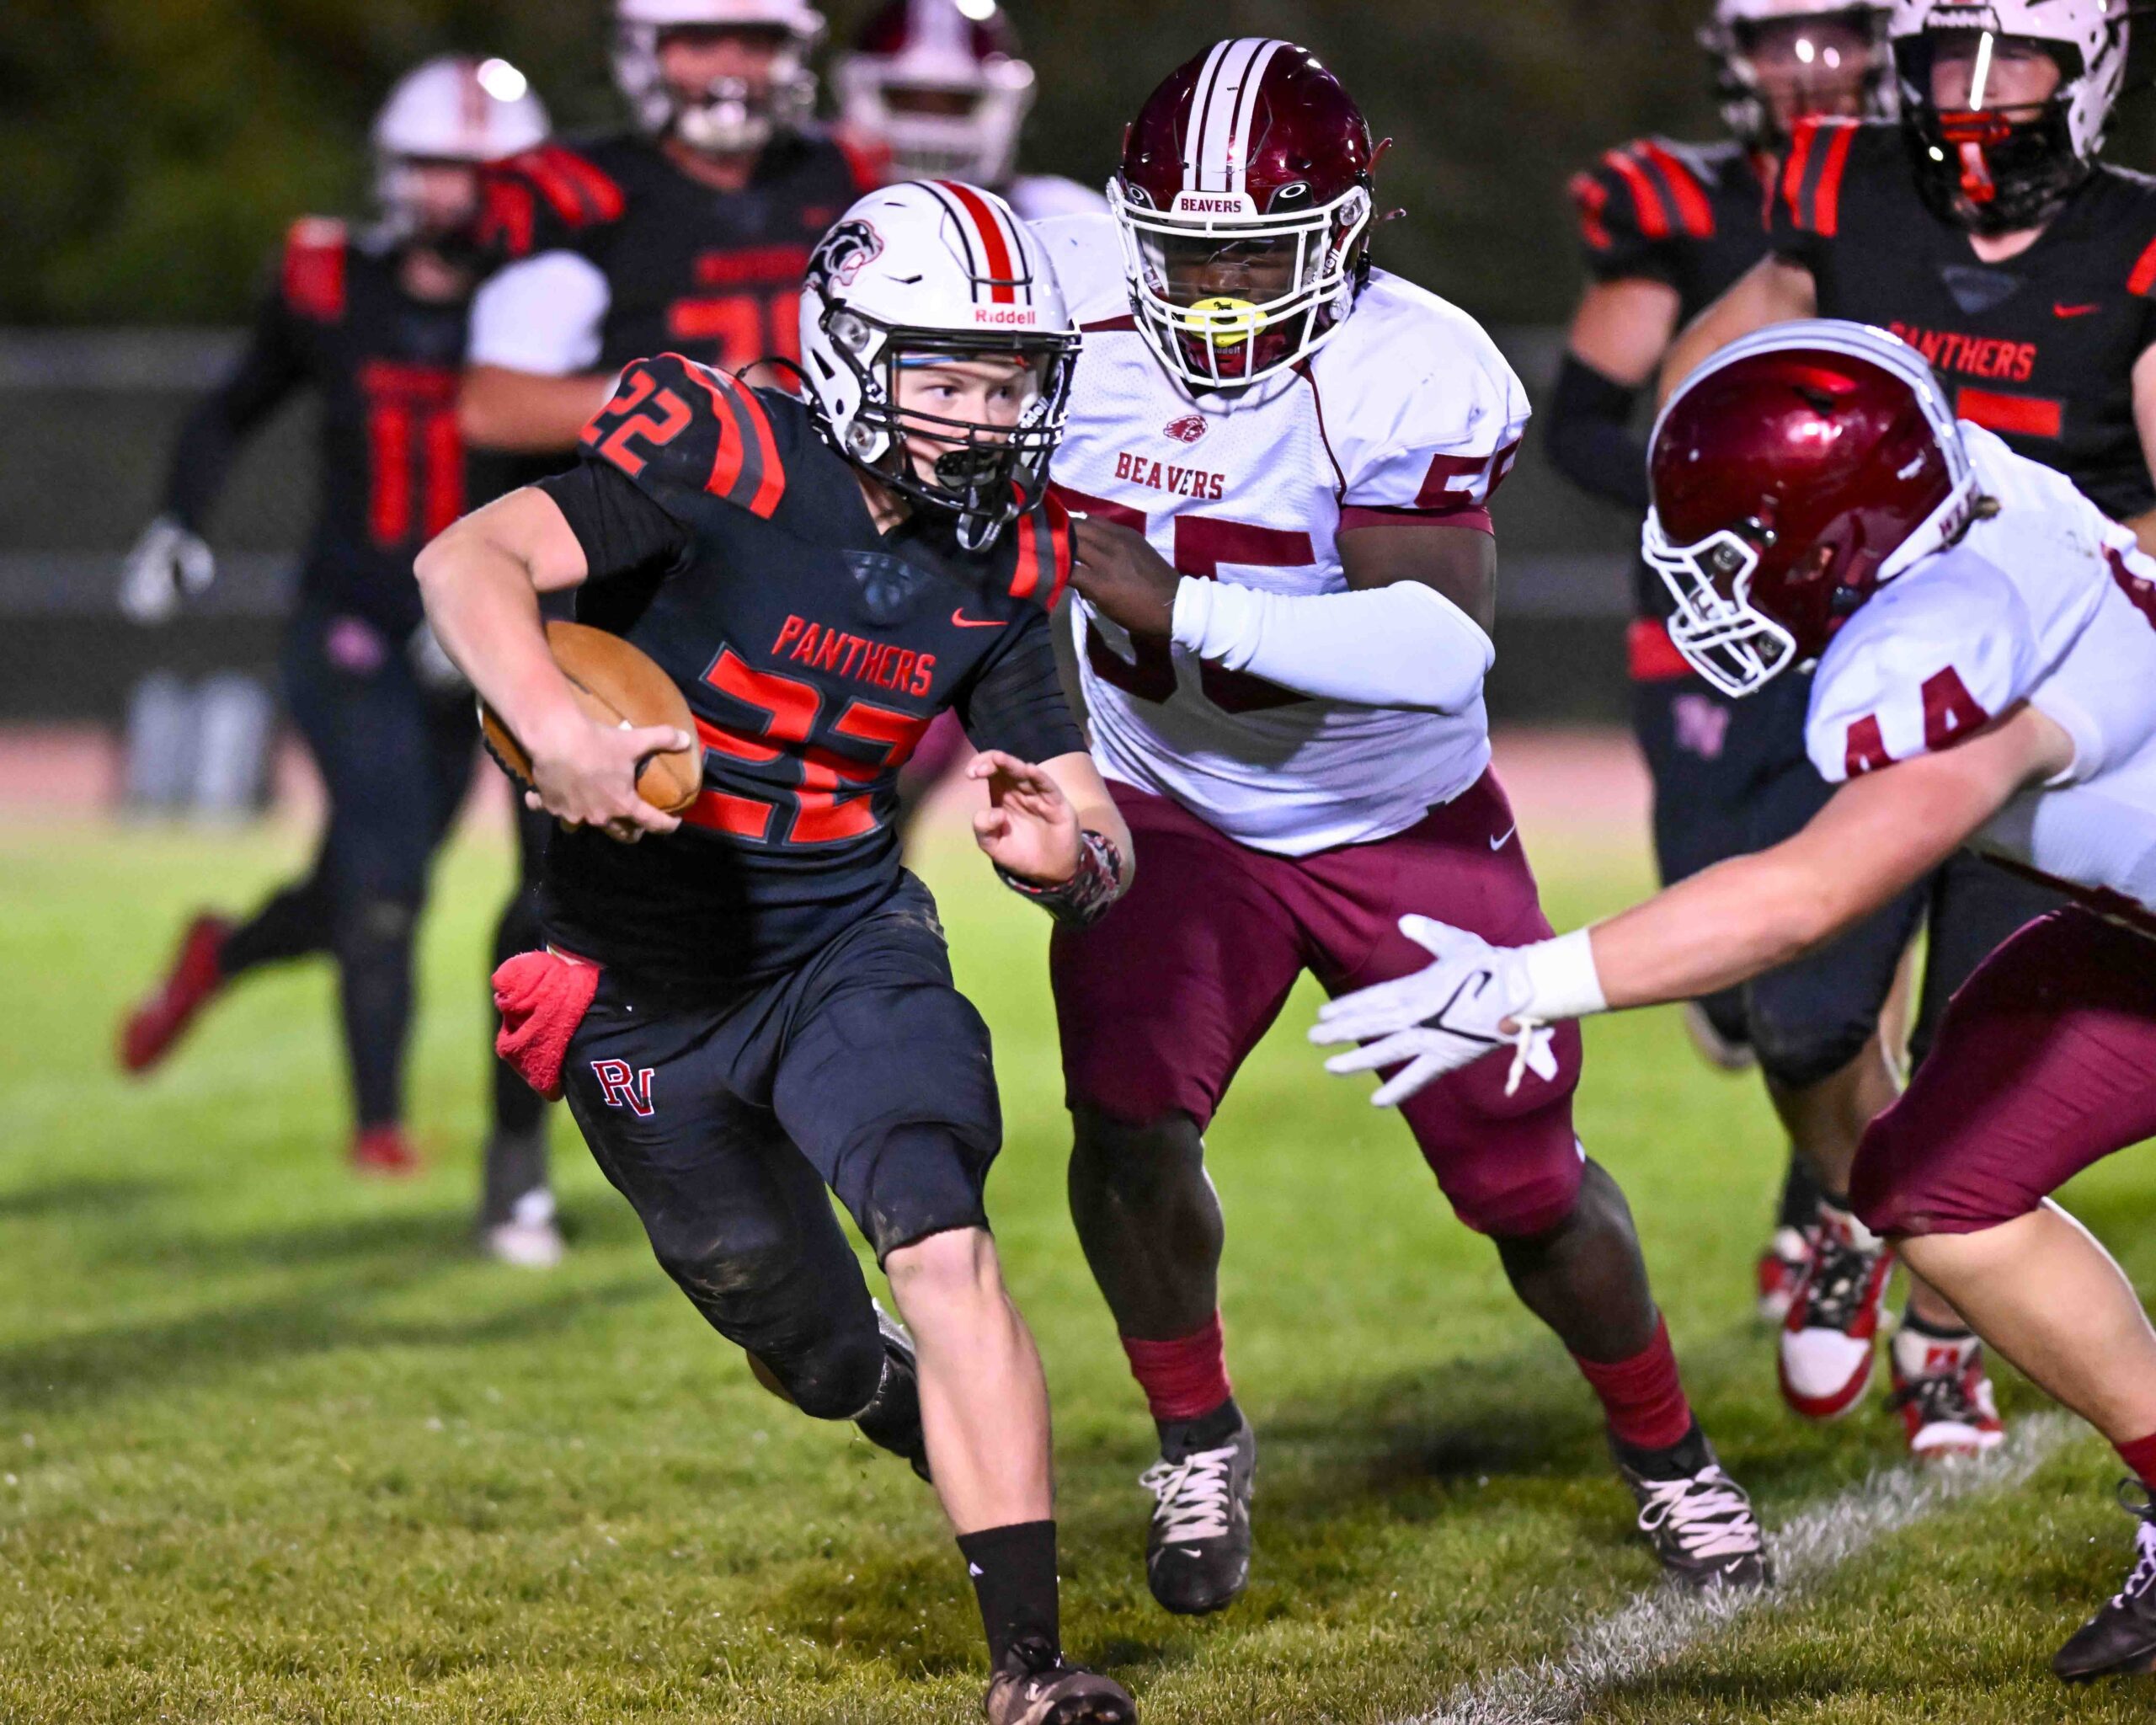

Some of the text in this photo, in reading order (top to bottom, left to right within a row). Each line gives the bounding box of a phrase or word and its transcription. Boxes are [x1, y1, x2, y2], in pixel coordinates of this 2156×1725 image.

[1181, 198, 1241, 213] BEAVERS
[975, 309, 1036, 324] Riddell
[580, 369, 692, 478] 22
[1115, 451, 1225, 499] BEAVERS
[771, 614, 937, 698] PANTHERS
[682, 641, 930, 846] 22
[590, 1059, 655, 1117] RV
